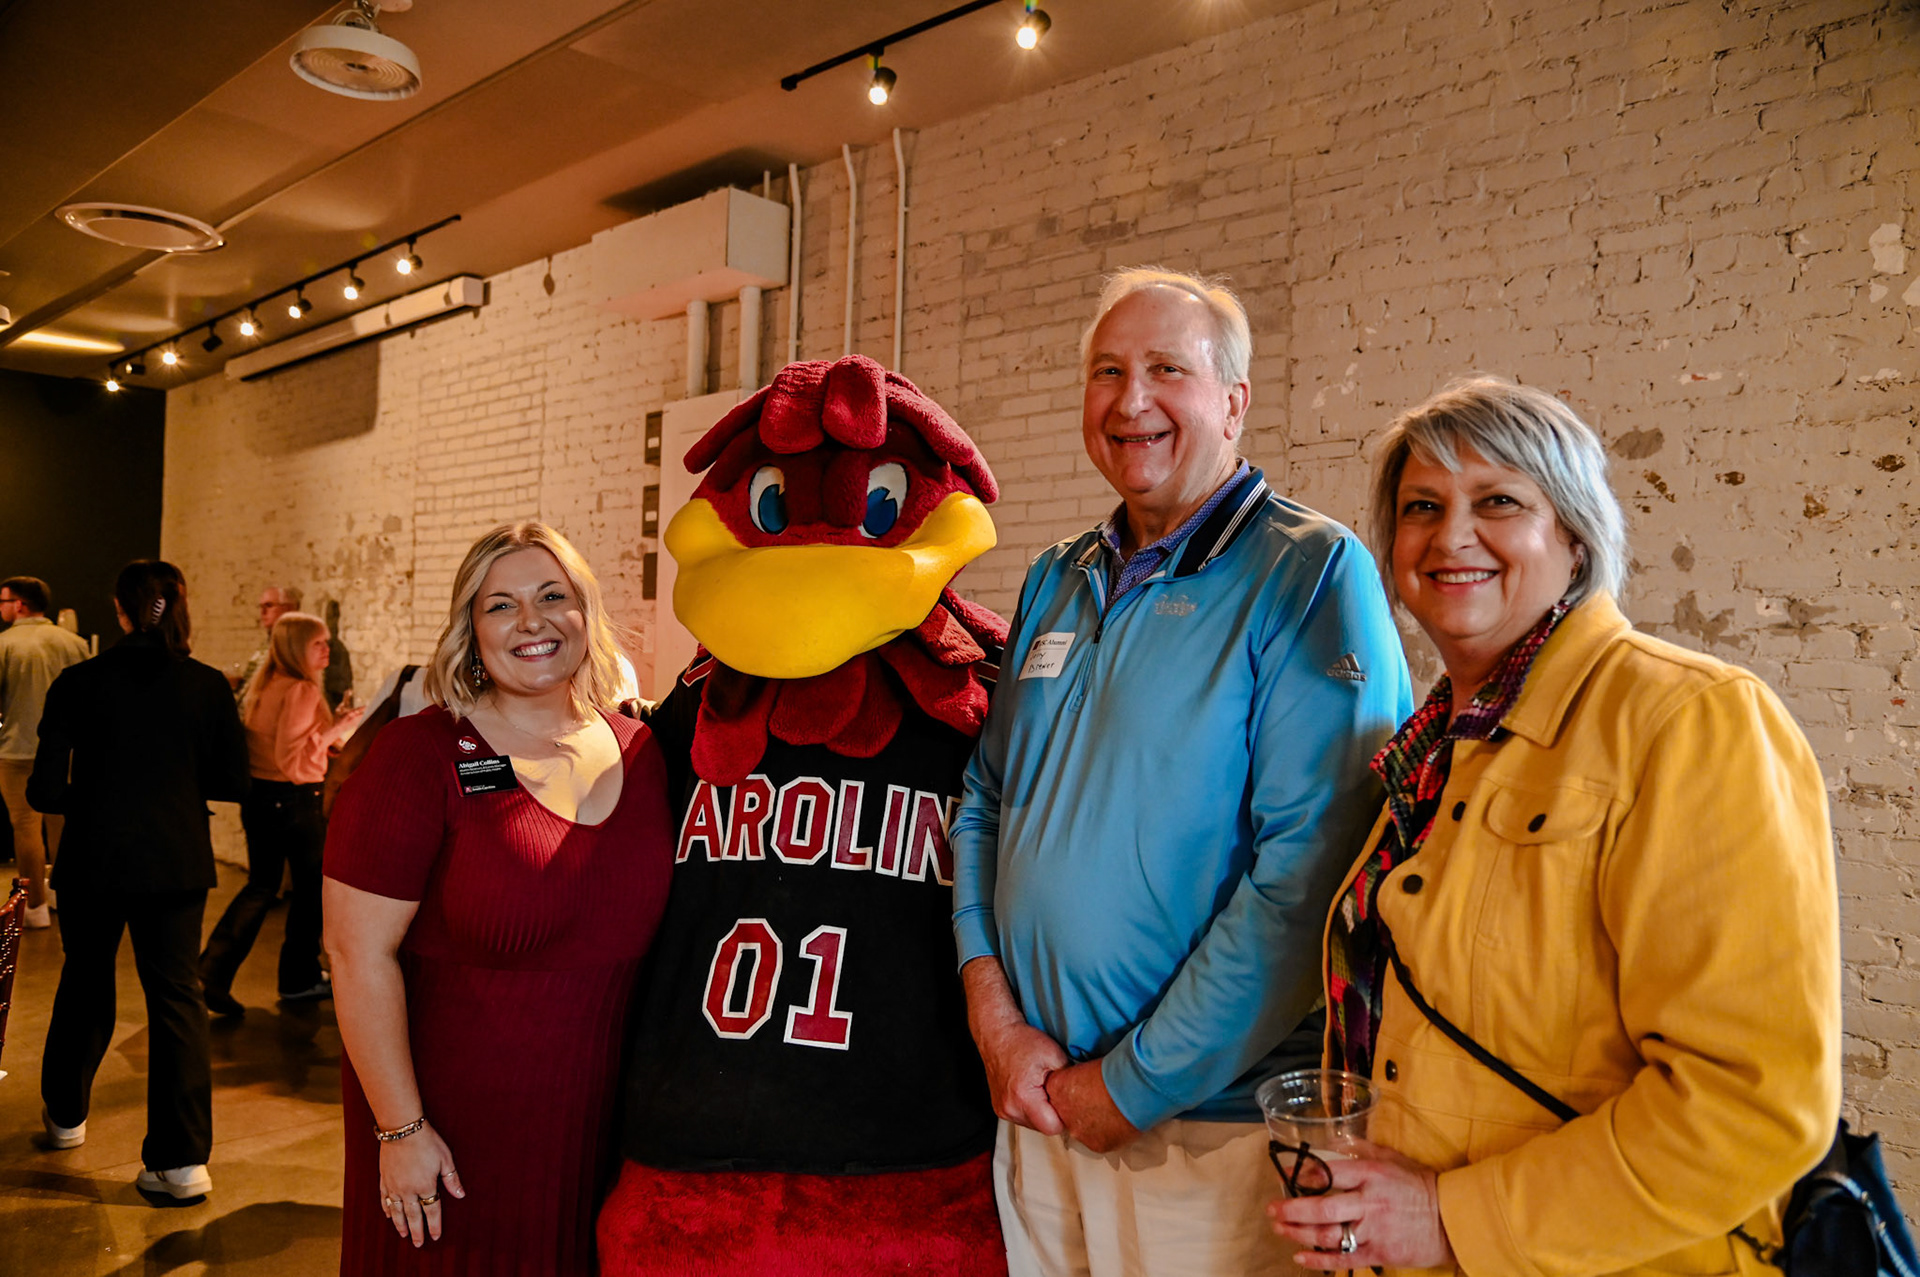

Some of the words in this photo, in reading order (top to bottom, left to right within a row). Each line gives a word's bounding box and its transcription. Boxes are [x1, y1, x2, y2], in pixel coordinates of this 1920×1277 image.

[1326, 668, 1367, 682] adidas
[675, 773, 962, 887] AROLIN
[702, 917, 853, 1051] 01
